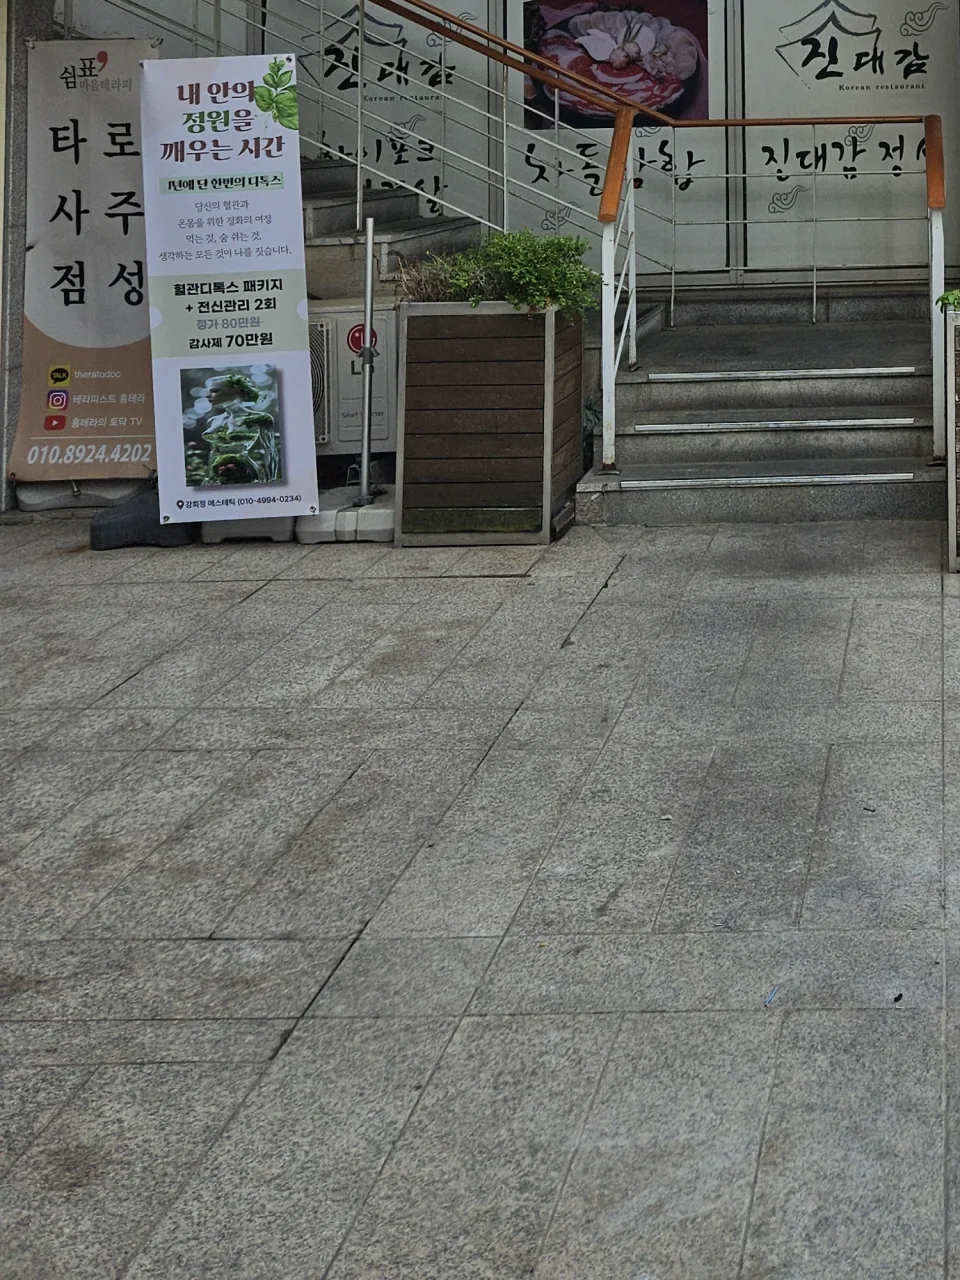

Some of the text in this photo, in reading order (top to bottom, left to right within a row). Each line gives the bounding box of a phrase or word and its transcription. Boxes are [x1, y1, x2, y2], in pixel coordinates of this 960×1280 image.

[79, 78, 133, 92] 마음테라피
[876, 83, 925, 91] restaurant
[176, 80, 255, 105] 내 안의
[182, 109, 254, 134] 정원을
[160, 135, 285, 163] 깨우는 시간
[168, 175, 282, 192] 1년에 단 한번의 디톡스
[195, 200, 249, 212] 당신의 혈관과
[206, 217, 223, 227] 위한
[226, 216, 252, 226] 정화의
[255, 215, 272, 224] 여정
[186, 234, 203, 244] 먹는
[231, 232, 248, 242] 쉬는
[159, 251, 193, 261] 생각하는
[195, 250, 212, 259] 모든
[215, 249, 232, 259] 것이
[235, 248, 252, 258] 나를
[173, 278, 283, 296] 혈관디톡스 패키지
[185, 297, 277, 314] + 전신관리 2회
[221, 316, 262, 329] 80만원
[189, 332, 273, 349] 감사제 70만원
[72, 395, 117, 404] 테라피스트
[130, 417, 143, 426] TV
[27, 443, 152, 465] 010.8924.4202
[185, 494, 302, 509] 강희정 에스테틱 (010-4994-0234)
